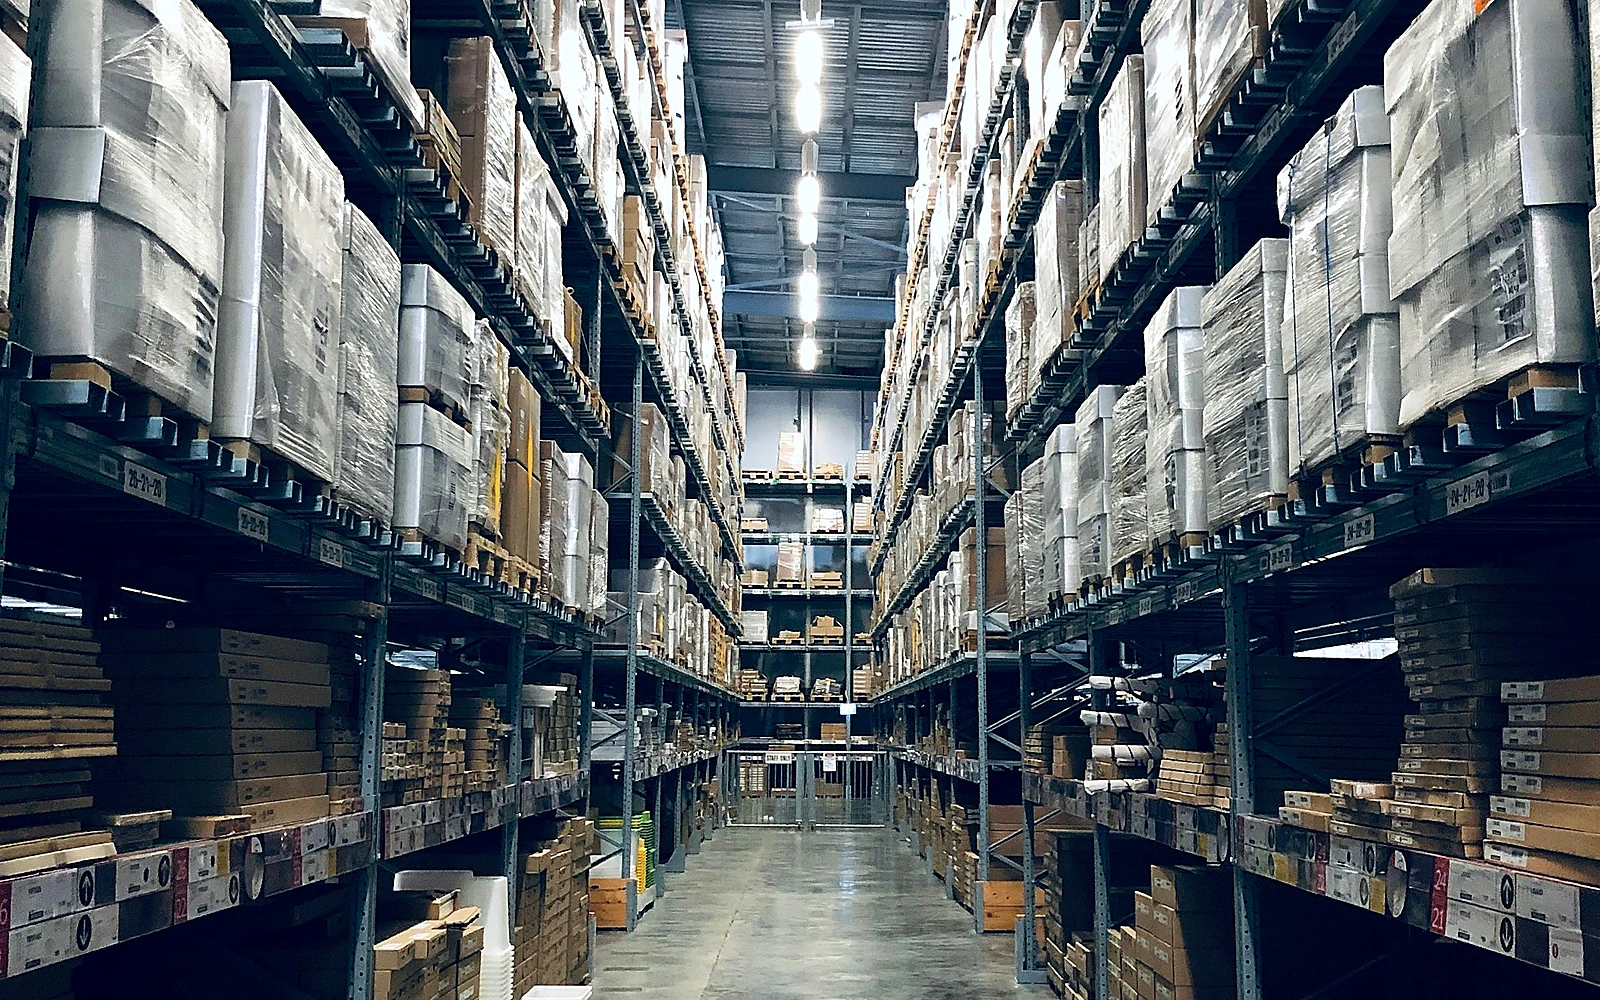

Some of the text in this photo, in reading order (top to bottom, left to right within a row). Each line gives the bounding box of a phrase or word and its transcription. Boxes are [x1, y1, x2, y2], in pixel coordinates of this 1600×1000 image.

[1451, 477, 1485, 508] 24-21-20
[1434, 869, 1447, 890] 24
[1431, 907, 1444, 930] 21
